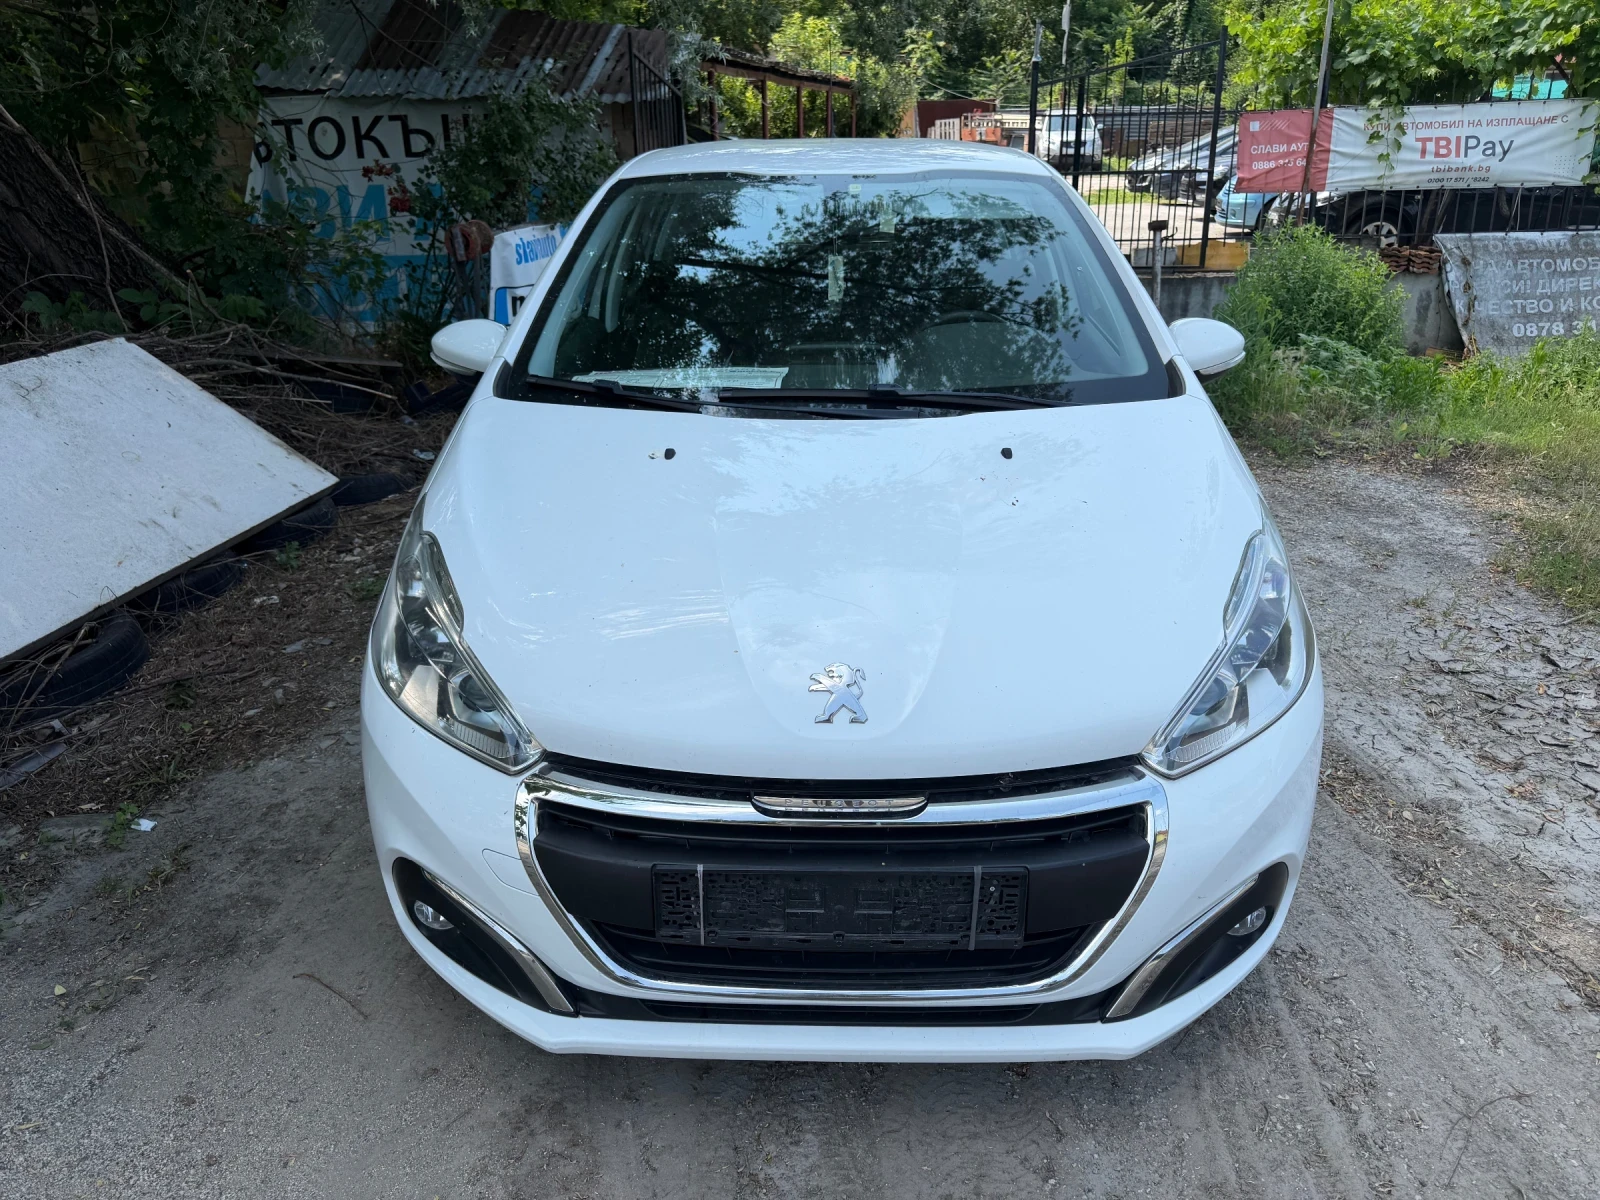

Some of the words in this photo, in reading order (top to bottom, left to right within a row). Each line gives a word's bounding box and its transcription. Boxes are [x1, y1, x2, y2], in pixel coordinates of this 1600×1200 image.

[1363, 123, 1391, 131] КУПИ
[1394, 120, 1464, 131] ВТОМОБИЛ
[1467, 120, 1483, 128] НА
[1486, 116, 1559, 128] ИЗПЛАЩАНЕ
[1561, 115, 1569, 124] С
[1251, 143, 1287, 155] СЛАВИ
[1290, 142, 1317, 152] АУТ
[1415, 135, 1514, 162] TBIPay
[1252, 160, 1275, 170] 0886
[1431, 165, 1491, 173] tbibank.bg
[1455, 299, 1553, 315] КЧЕСТВО
[1512, 321, 1564, 337] 0878
